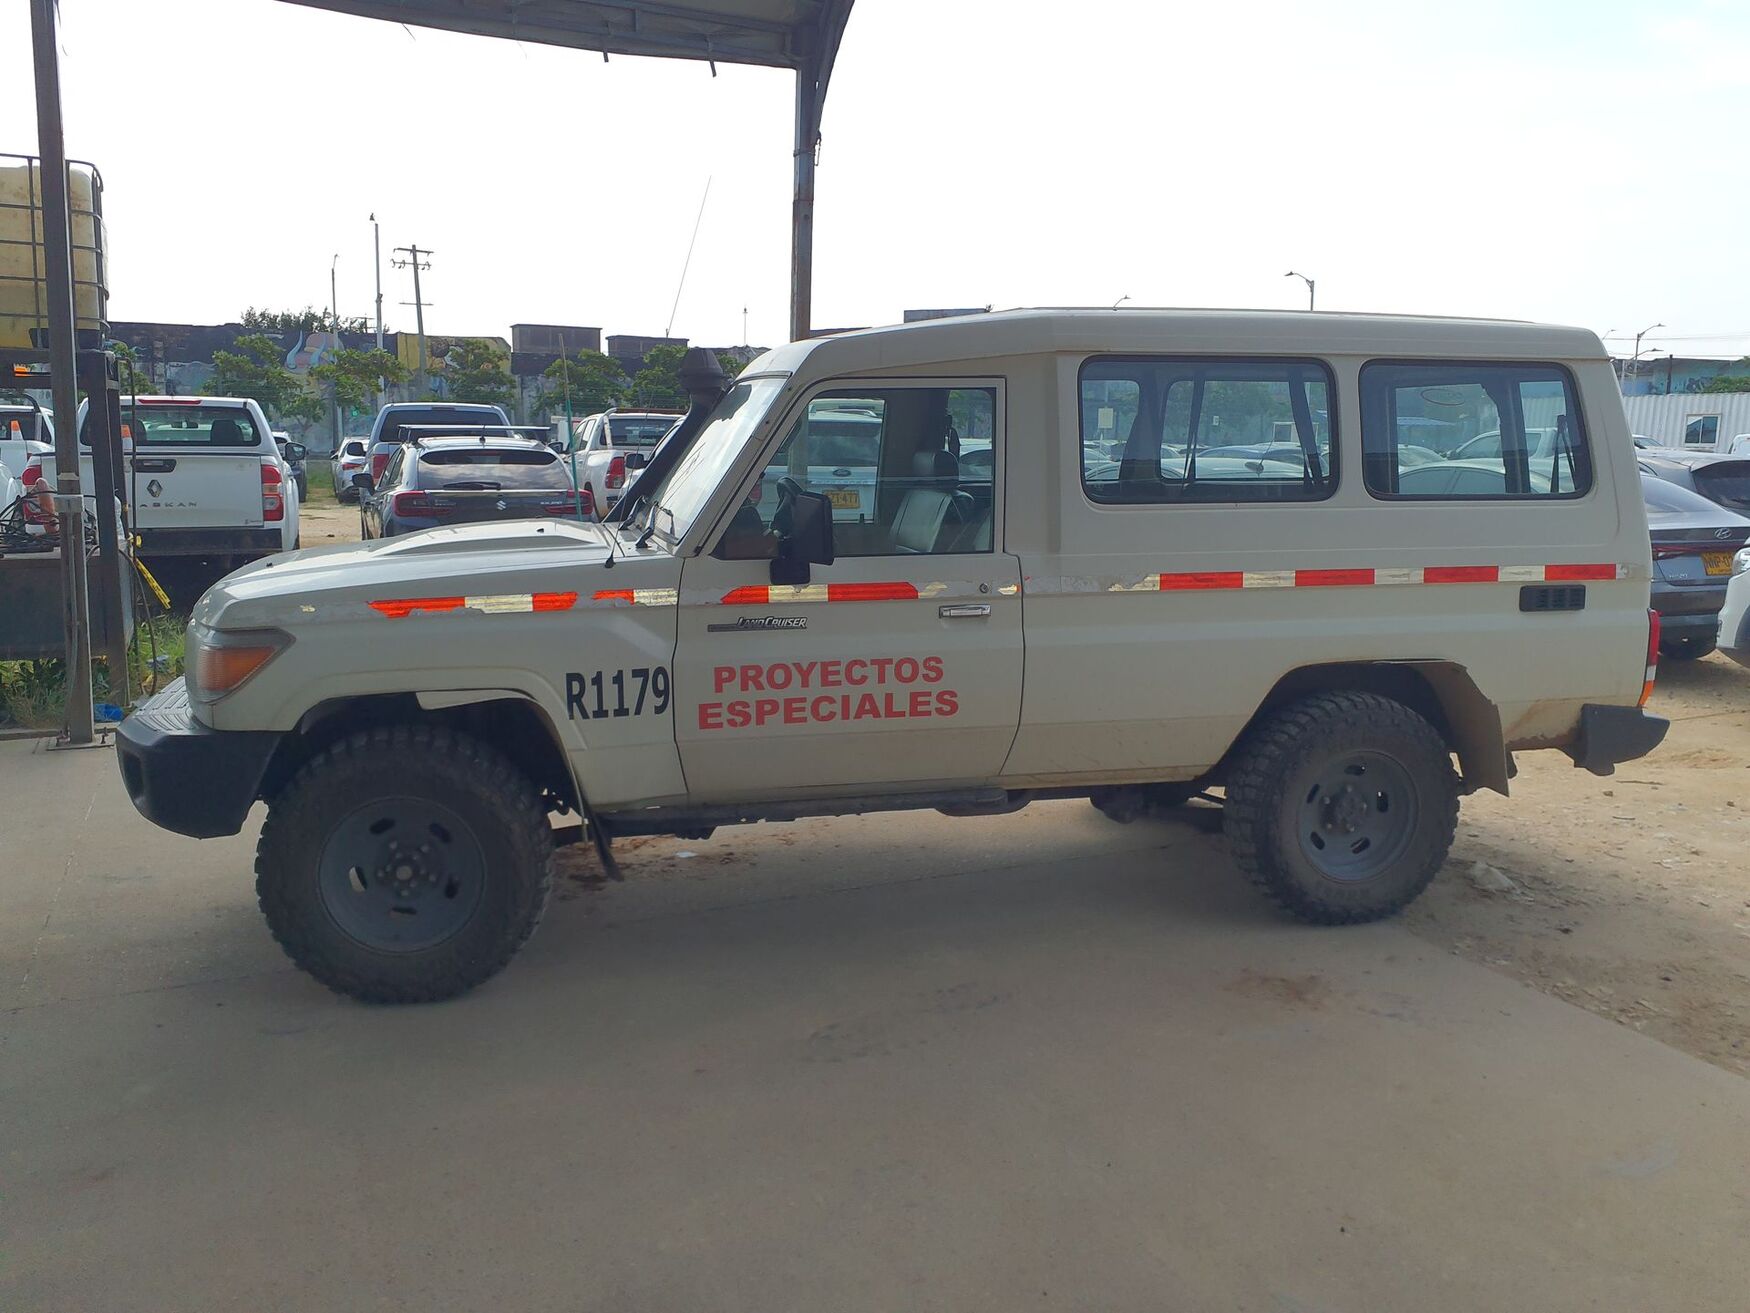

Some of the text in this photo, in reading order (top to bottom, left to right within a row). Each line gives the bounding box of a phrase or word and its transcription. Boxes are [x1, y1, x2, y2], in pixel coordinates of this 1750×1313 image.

[566, 666, 670, 720] R1179
[714, 656, 944, 693] PROYECTOS
[698, 690, 959, 730] ESPECIALES
